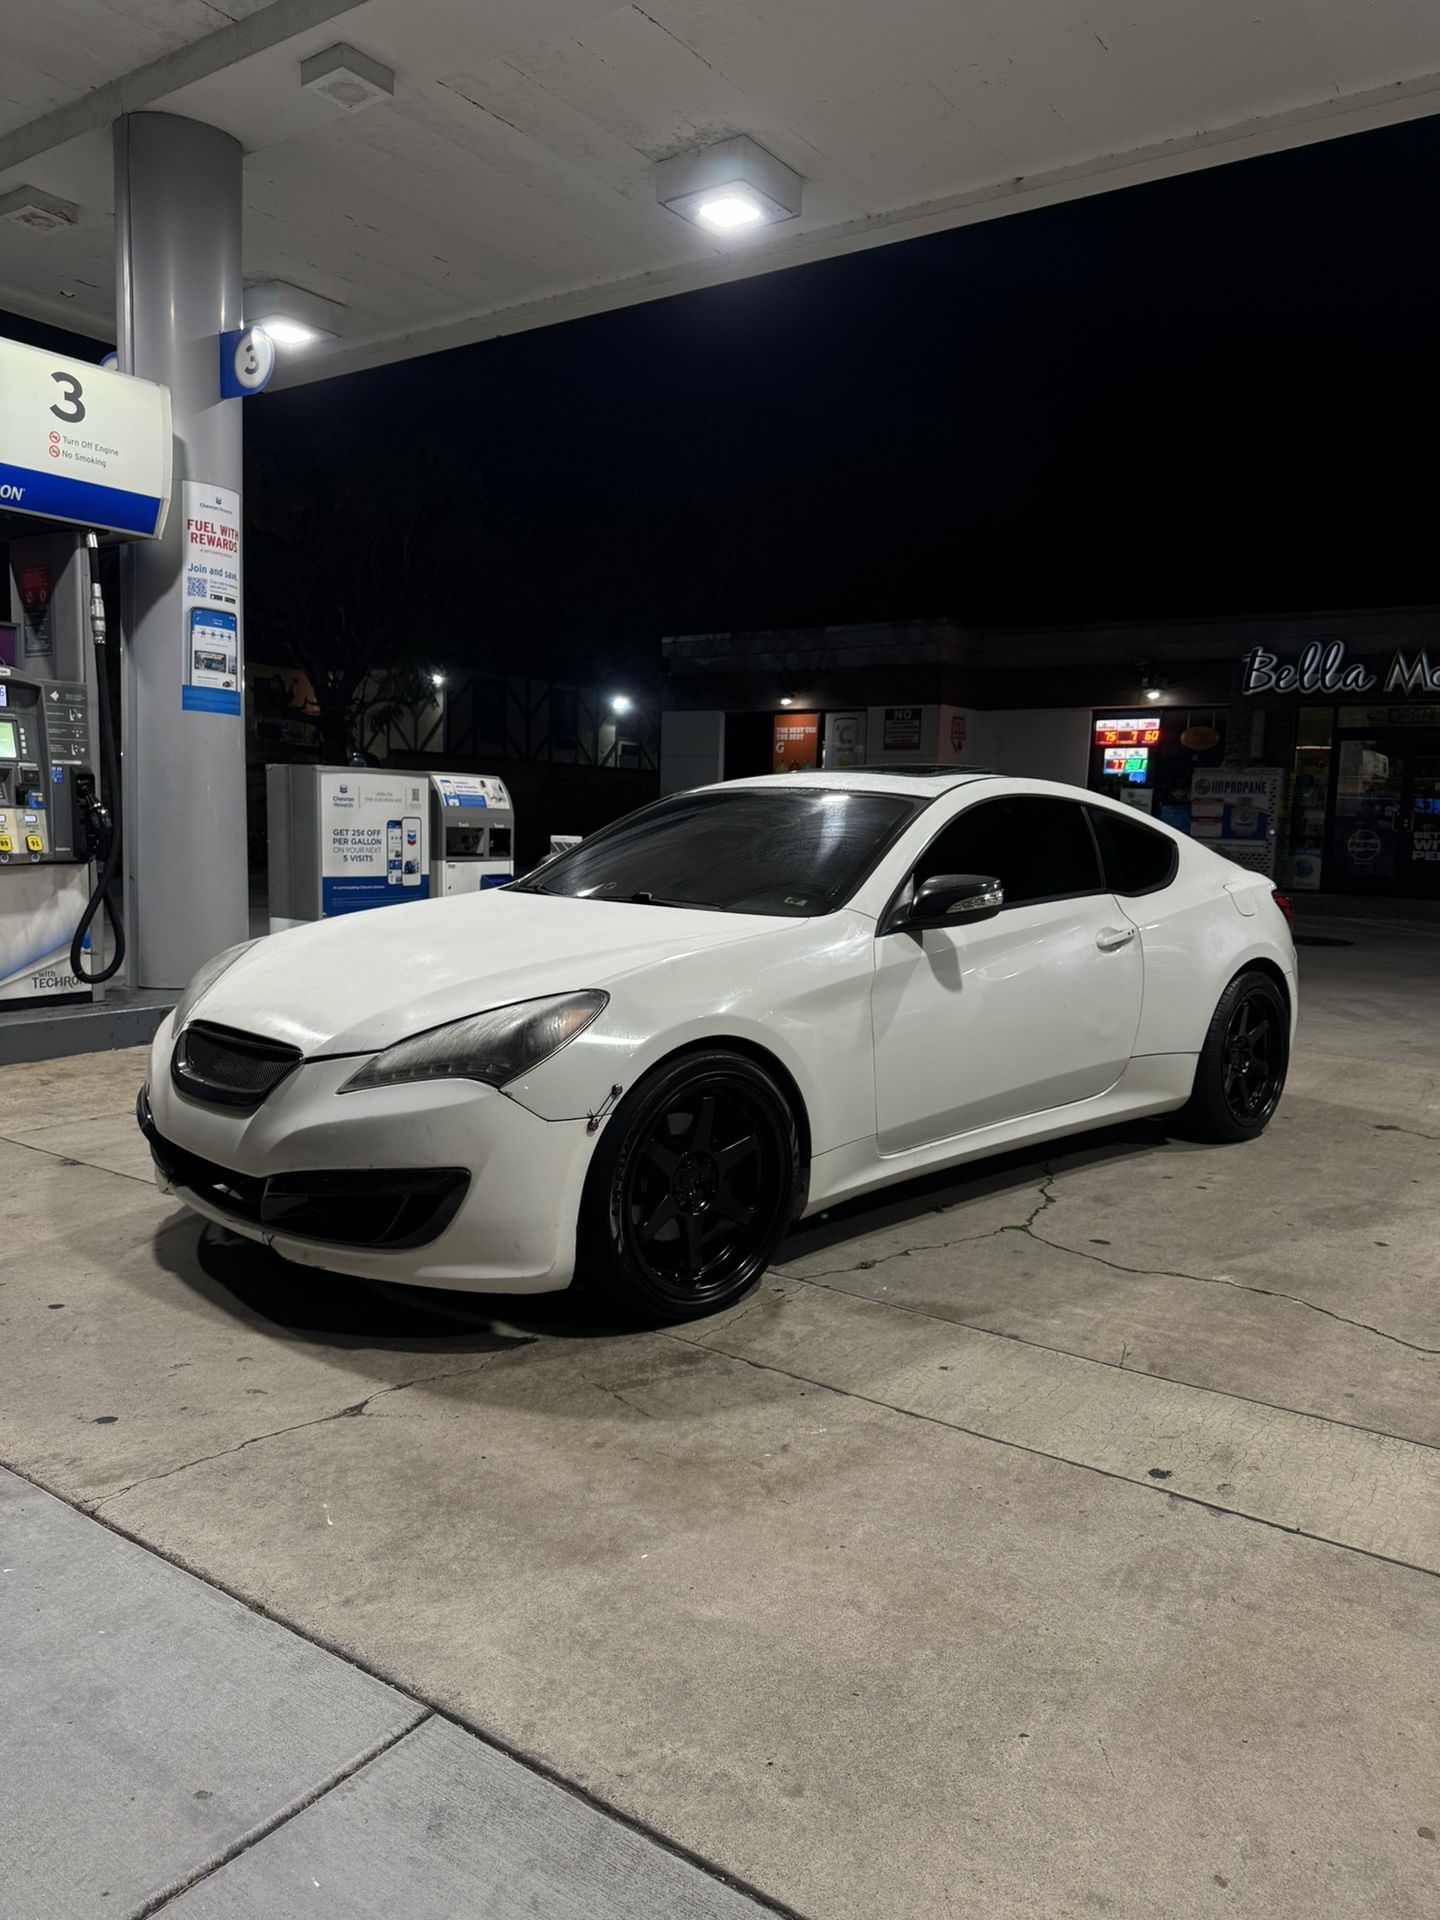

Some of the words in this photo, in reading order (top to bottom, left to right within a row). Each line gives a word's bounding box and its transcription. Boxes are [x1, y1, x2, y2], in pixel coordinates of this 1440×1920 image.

[245, 345, 259, 375] 3
[49, 371, 86, 424] 3
[62, 435, 80, 447] Turn
[81, 440, 93, 450] Off
[94, 444, 120, 457] Engine
[62, 450, 73, 459] No
[75, 454, 107, 469] Smoking
[187, 518, 217, 534] FUEL
[220, 524, 239, 541] WITH
[190, 532, 238, 553] REWARDS
[188, 563, 208, 574] Join
[209, 567, 223, 577] and
[1240, 639, 1377, 696] Bella
[894, 708, 913, 720] NO
[1104, 731, 1117, 741] 75
[1144, 730, 1160, 741] 60
[775, 741, 785, 754] G
[333, 838, 349, 846] PER
[350, 838, 382, 846] GALLON
[38, 969, 56, 978] with
[32, 976, 86, 989] TECHRO
